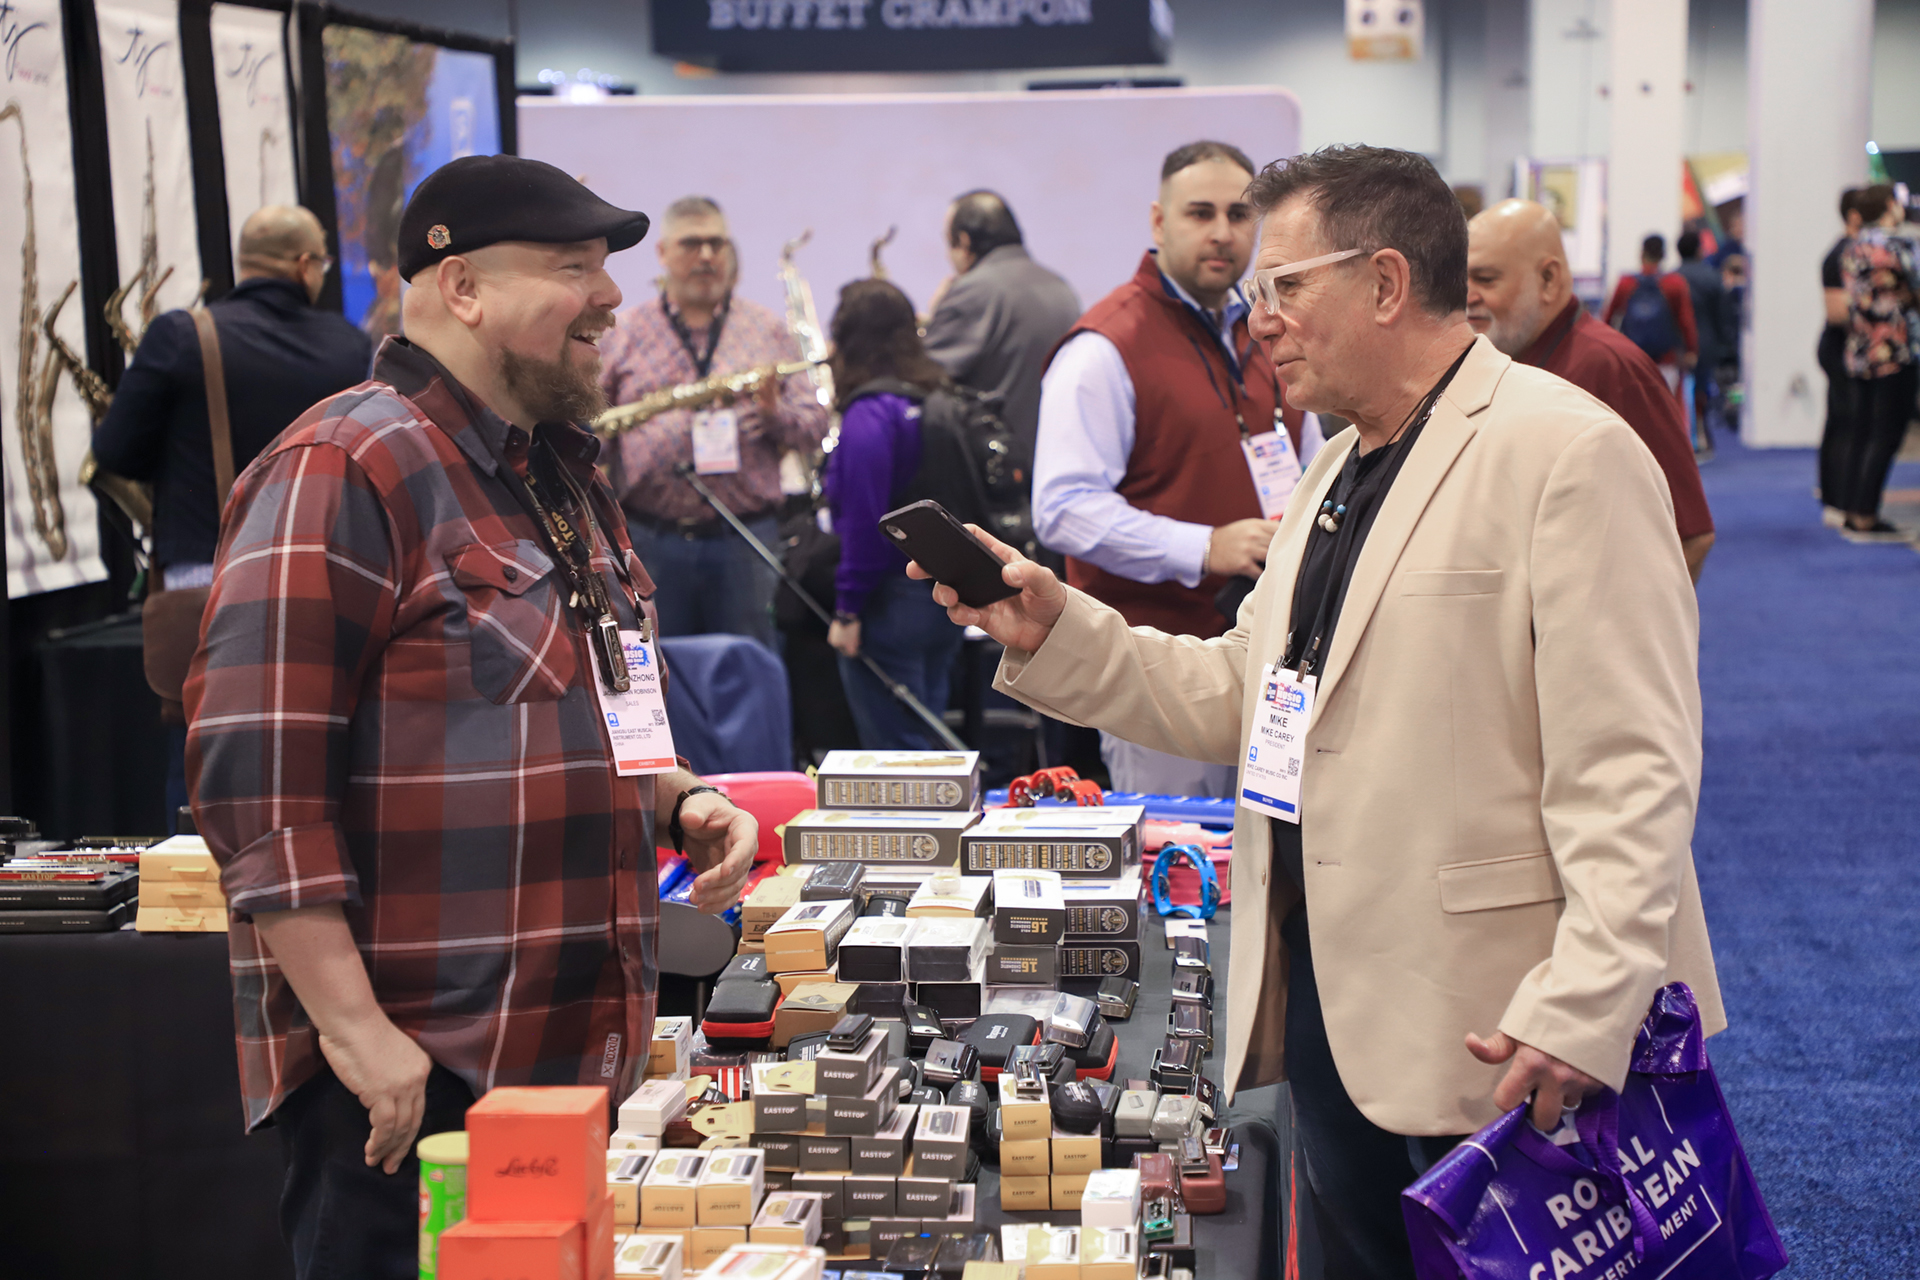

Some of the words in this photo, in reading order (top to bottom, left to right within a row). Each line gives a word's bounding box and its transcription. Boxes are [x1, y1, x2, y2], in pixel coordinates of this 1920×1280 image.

[707, 0, 868, 30] BUFFET
[880, 0, 1093, 28] CRAMPON
[552, 512, 576, 541] TOP
[624, 650, 644, 658] USIC
[1269, 714, 1288, 728] MIKE
[1261, 726, 1274, 739] MIKE
[1274, 730, 1295, 743] CAREY
[1264, 739, 1286, 750] PRESIDENT
[1265, 768, 1275, 777] MUSIC
[1032, 921, 1048, 933] 16
[1021, 961, 1038, 973] 16
[824, 1070, 855, 1080] EASTTOP
[834, 1110, 865, 1119] EASTTOP
[1545, 1136, 1656, 1230] ROAL
[1529, 1138, 1701, 1280] CARIBEAN
